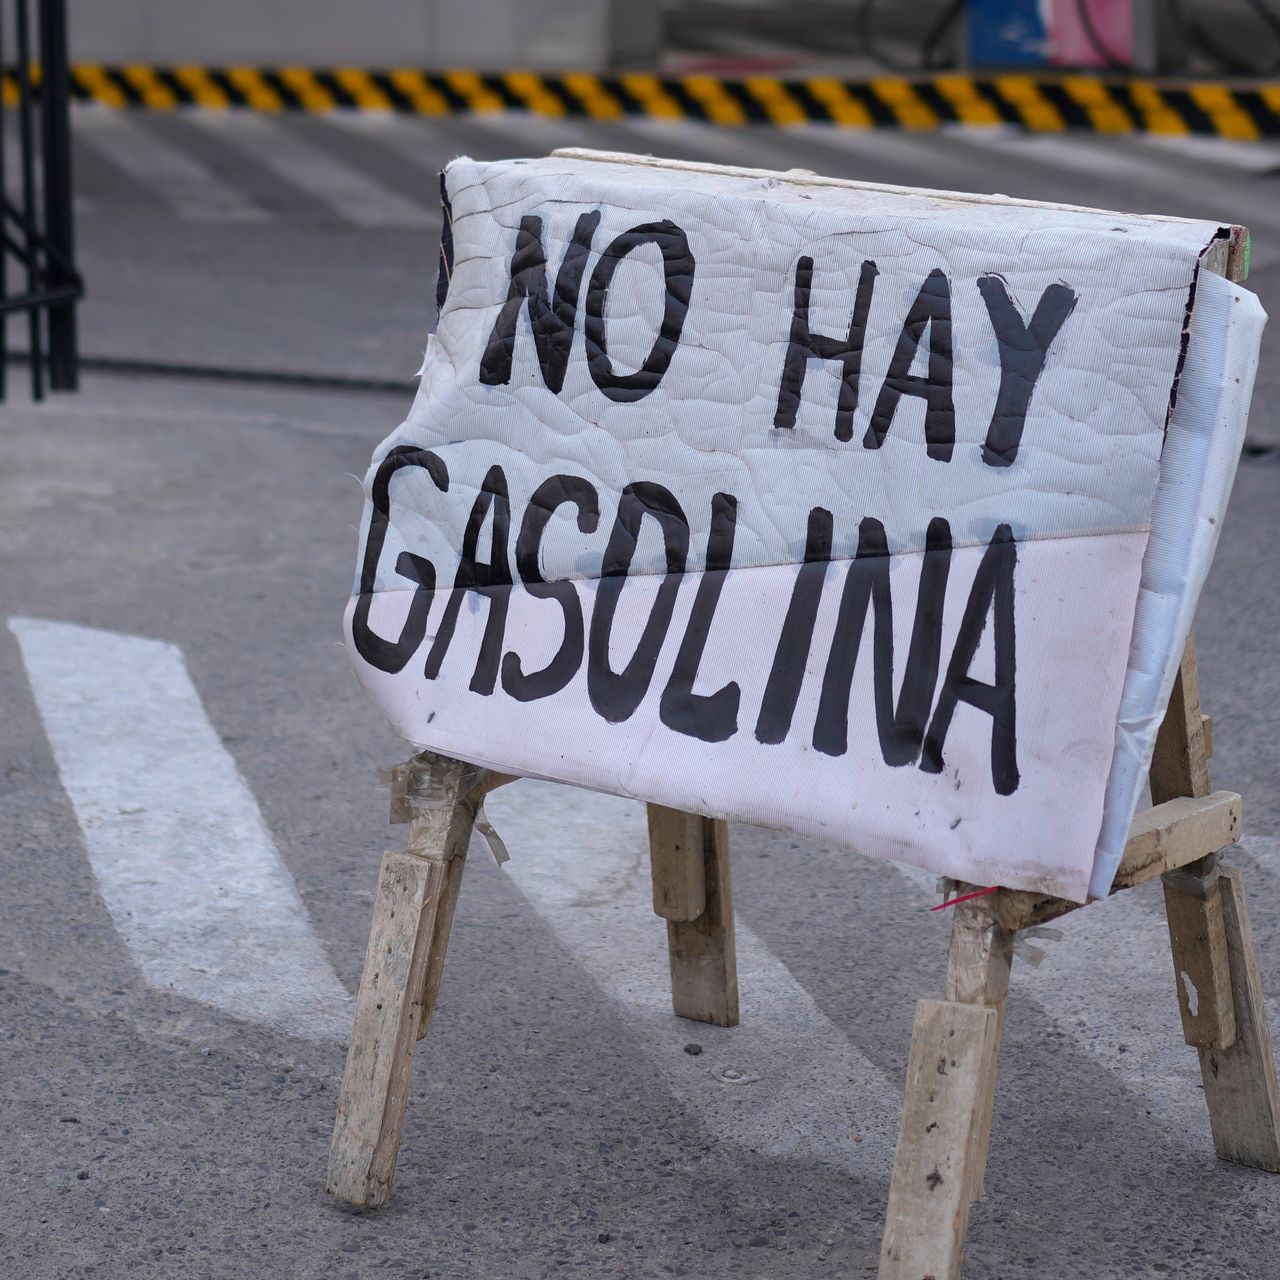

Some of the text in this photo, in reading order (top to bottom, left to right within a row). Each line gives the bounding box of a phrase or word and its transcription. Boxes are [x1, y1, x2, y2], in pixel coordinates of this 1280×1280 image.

[478, 210, 1077, 468] NO HAY
[352, 445, 1019, 796] GASOLINA
